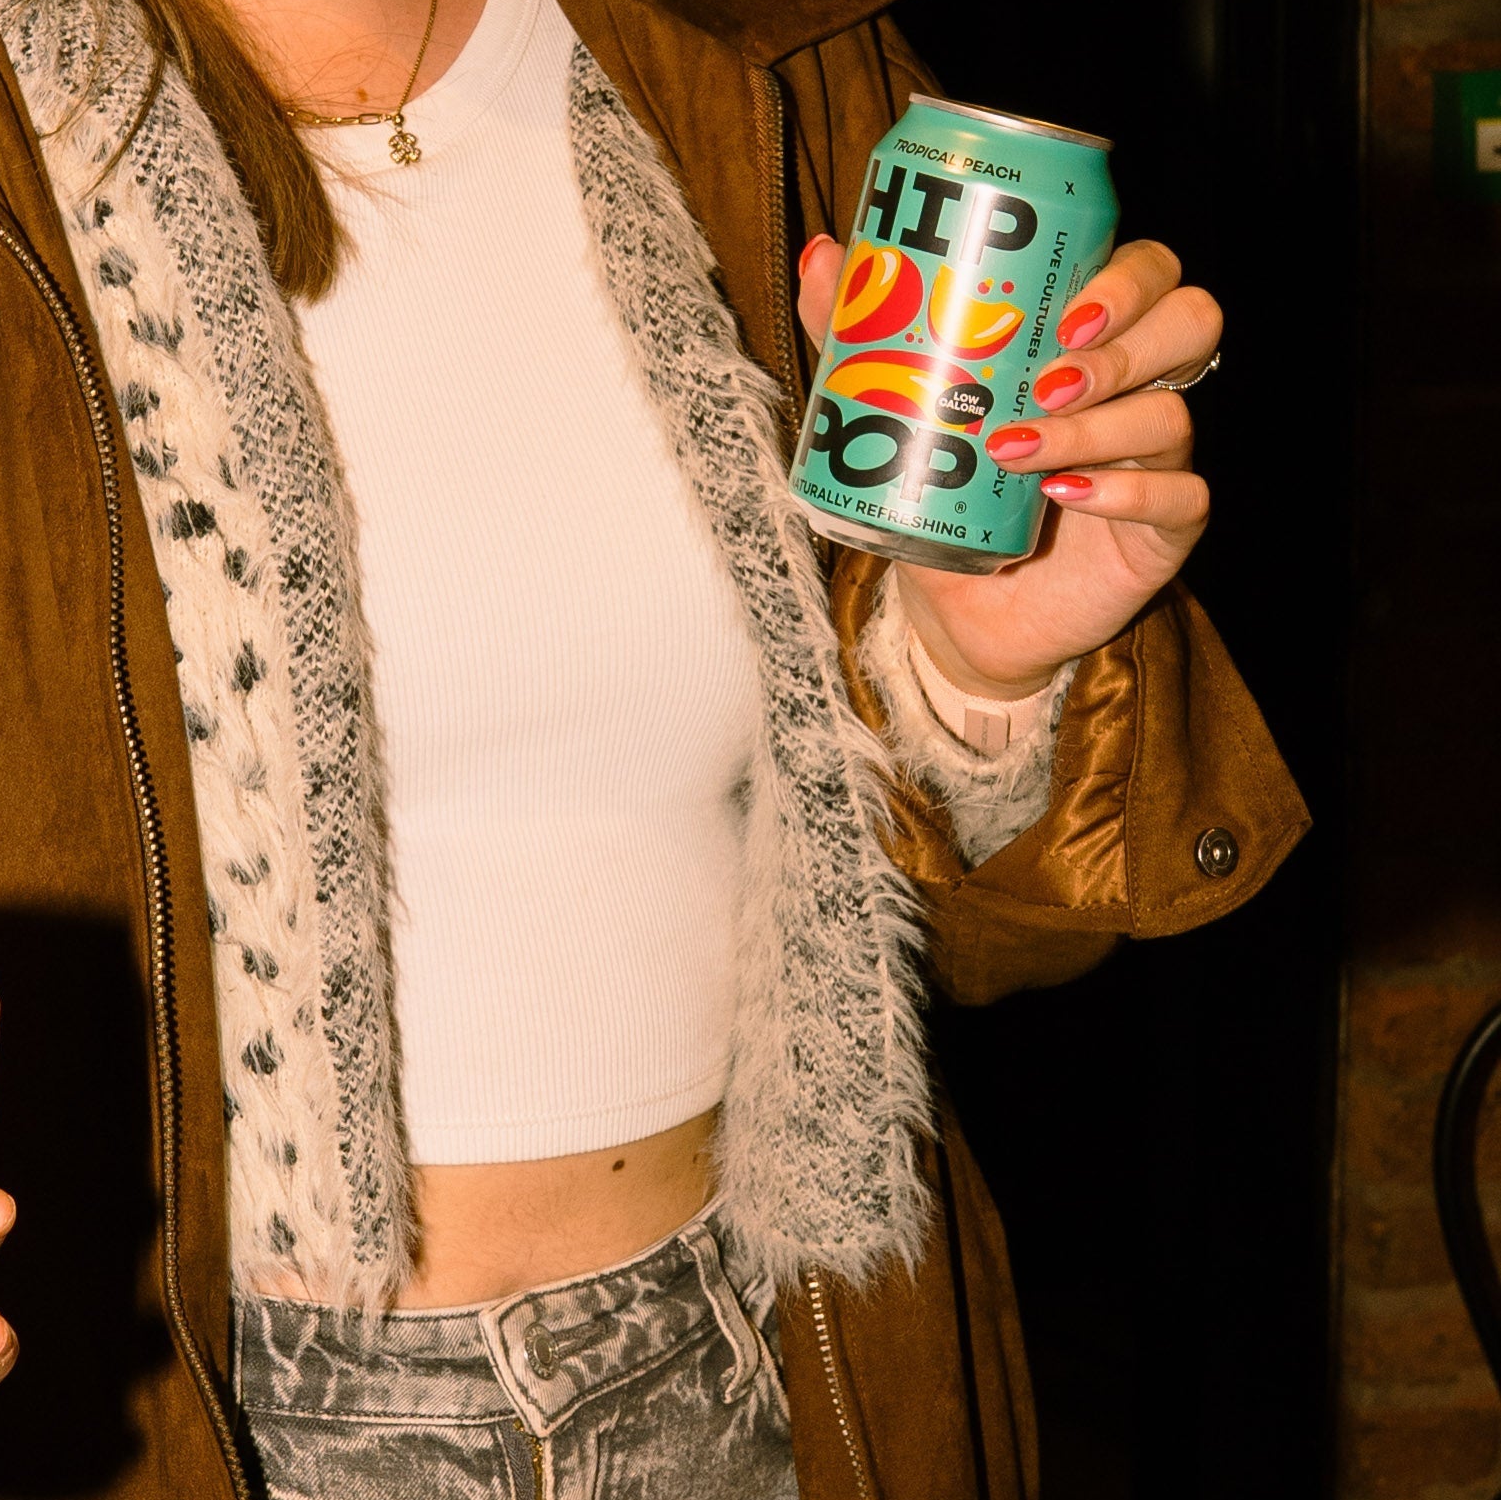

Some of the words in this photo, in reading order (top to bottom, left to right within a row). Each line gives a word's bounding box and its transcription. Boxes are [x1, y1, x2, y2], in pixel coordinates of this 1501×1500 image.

[893, 138, 956, 166] TROPICAL
[963, 157, 1021, 183] PEACH
[857, 159, 1038, 265] HIP
[1049, 231, 1068, 269] LIVE
[1027, 273, 1057, 359] CULTURES
[938, 397, 985, 416] CALORIE
[953, 391, 979, 405] LOW
[1013, 380, 1029, 416] GUT
[798, 394, 977, 504] POP
[855, 500, 967, 539] REFRESHING
